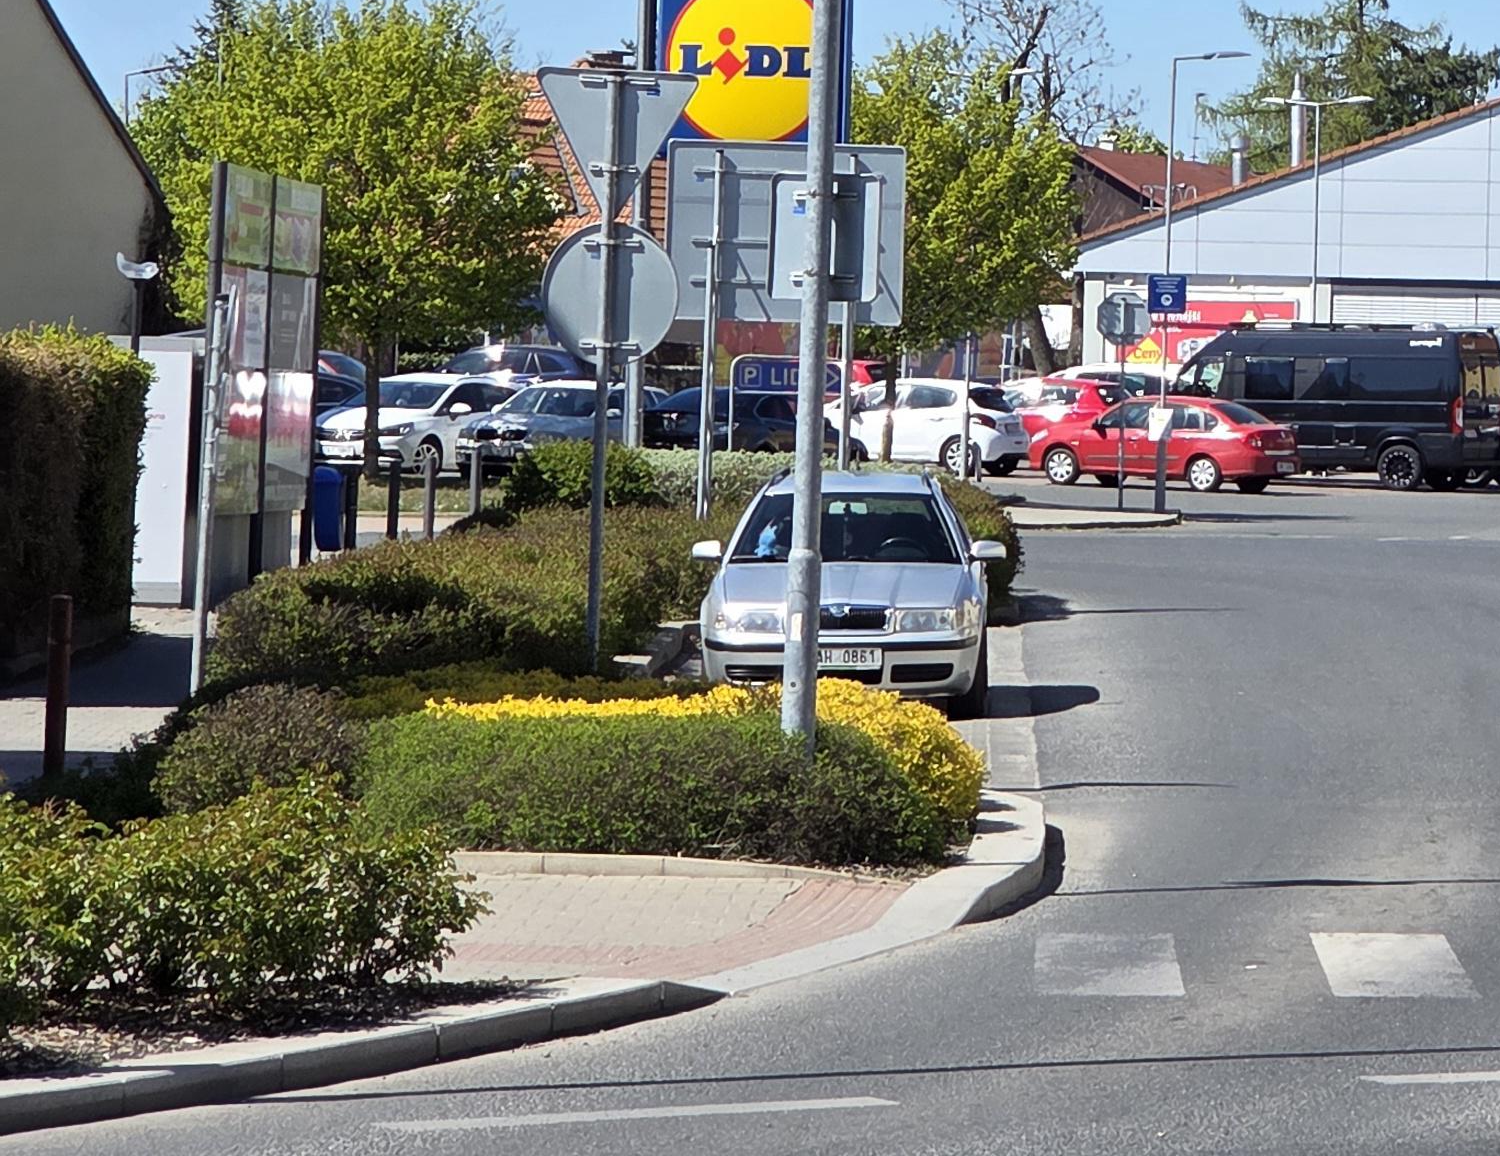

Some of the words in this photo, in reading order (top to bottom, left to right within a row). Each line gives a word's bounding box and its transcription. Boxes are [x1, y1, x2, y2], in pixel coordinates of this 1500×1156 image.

[678, 28, 812, 85] LIDL
[744, 367, 757, 384] P
[770, 367, 799, 386] LID
[843, 649, 875, 664] 0861
